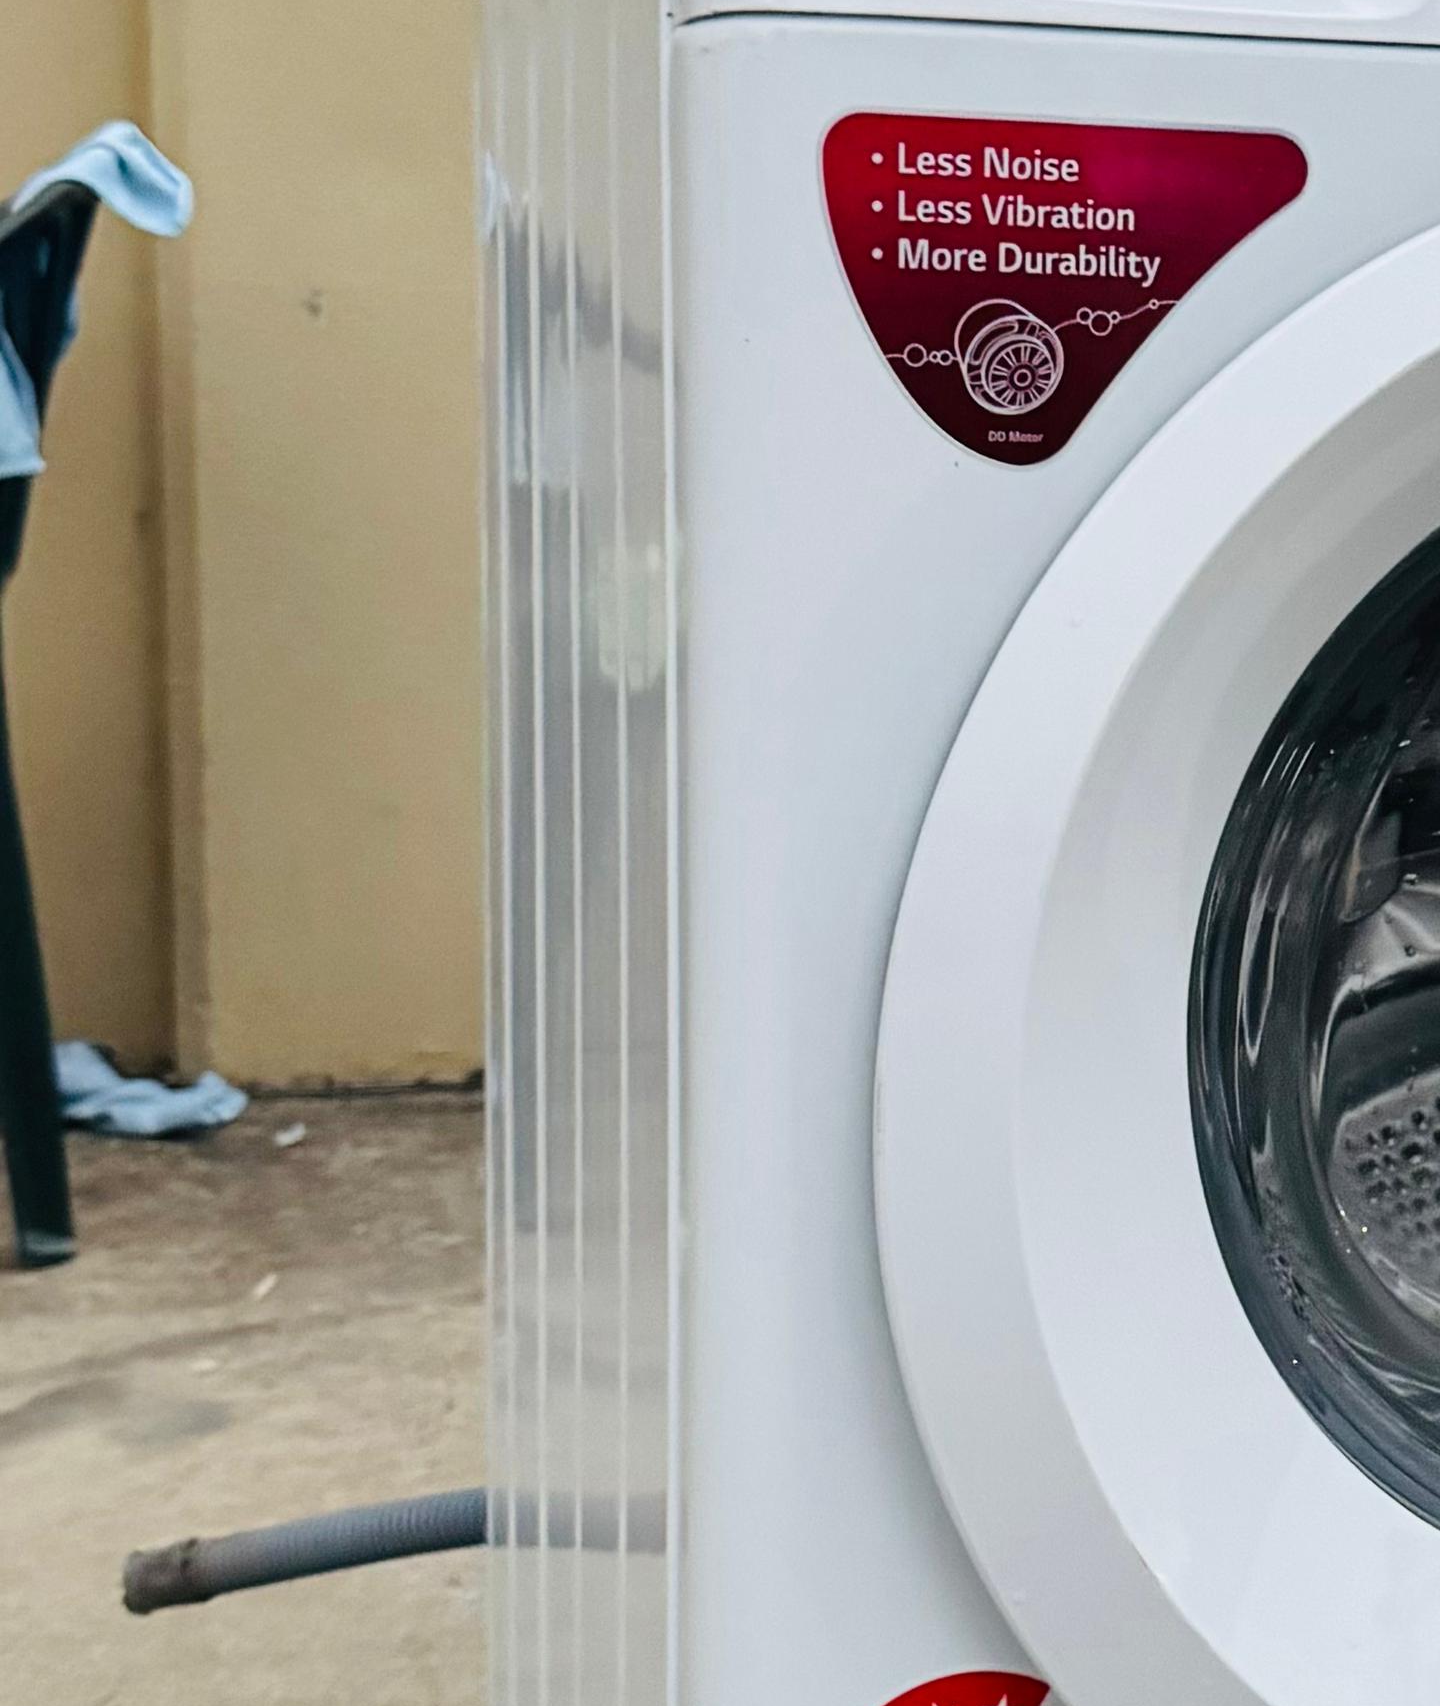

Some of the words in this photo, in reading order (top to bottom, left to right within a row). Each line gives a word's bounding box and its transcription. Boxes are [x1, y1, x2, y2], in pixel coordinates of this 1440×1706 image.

[898, 142, 971, 177] Less
[984, 146, 1079, 182] Noise
[898, 190, 971, 224] Less
[982, 194, 1135, 231] Vibration
[898, 238, 987, 272] More
[998, 242, 1161, 288] Durability
